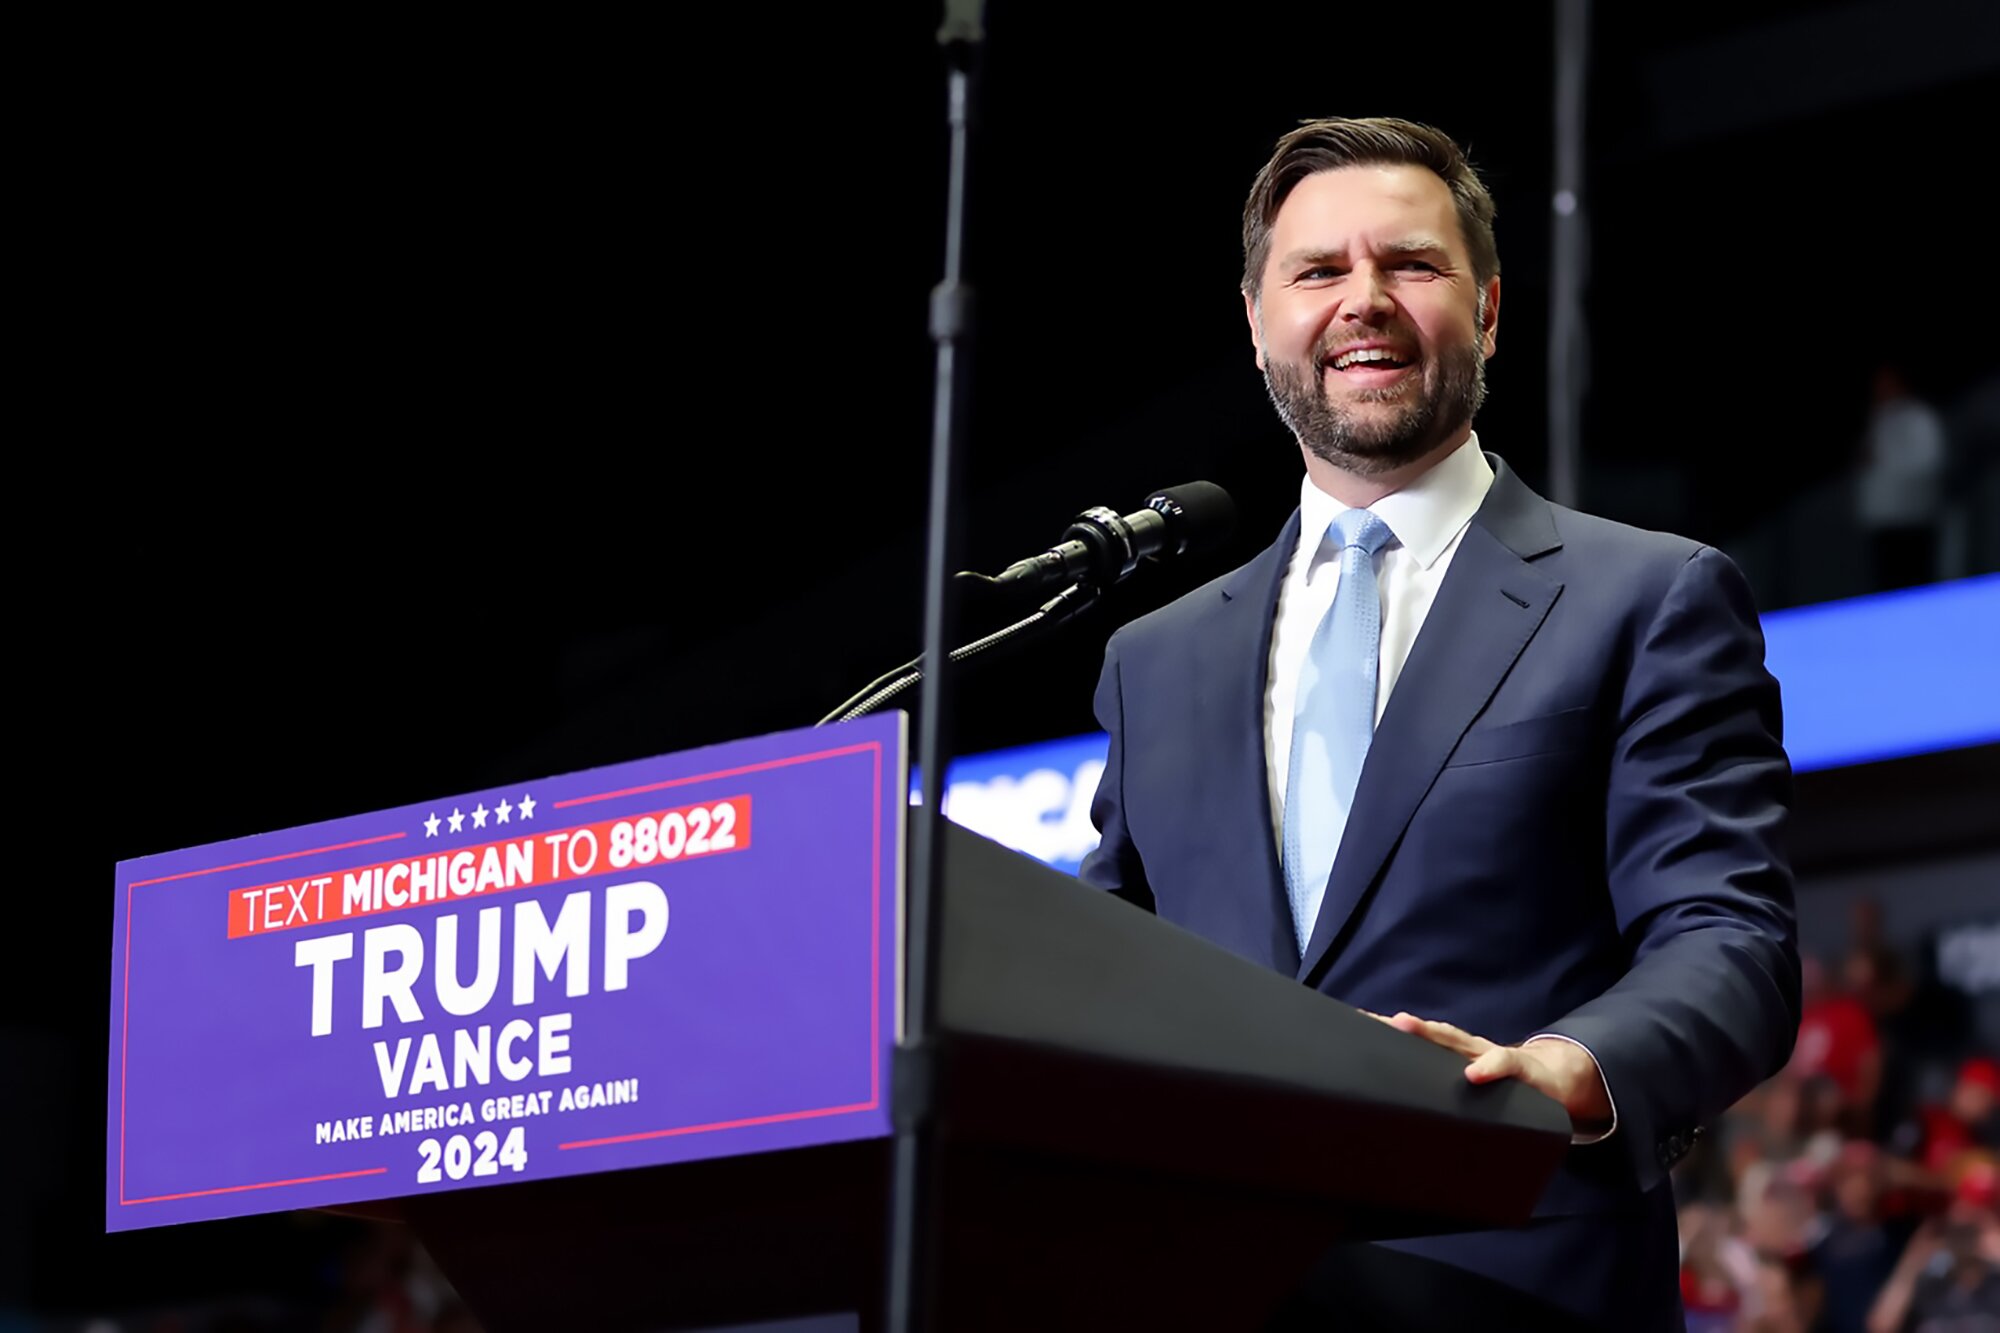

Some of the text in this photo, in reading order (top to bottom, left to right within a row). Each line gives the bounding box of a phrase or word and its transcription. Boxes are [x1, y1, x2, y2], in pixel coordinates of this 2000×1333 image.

[242, 802, 736, 932] TEXT MICHIGAN TO 88022
[294, 881, 670, 1037] TRUMP
[373, 1012, 572, 1099] VANCE
[315, 1078, 639, 1145] MAKE AMERICA GREAT AGAIN!
[416, 1126, 528, 1184] 2024
